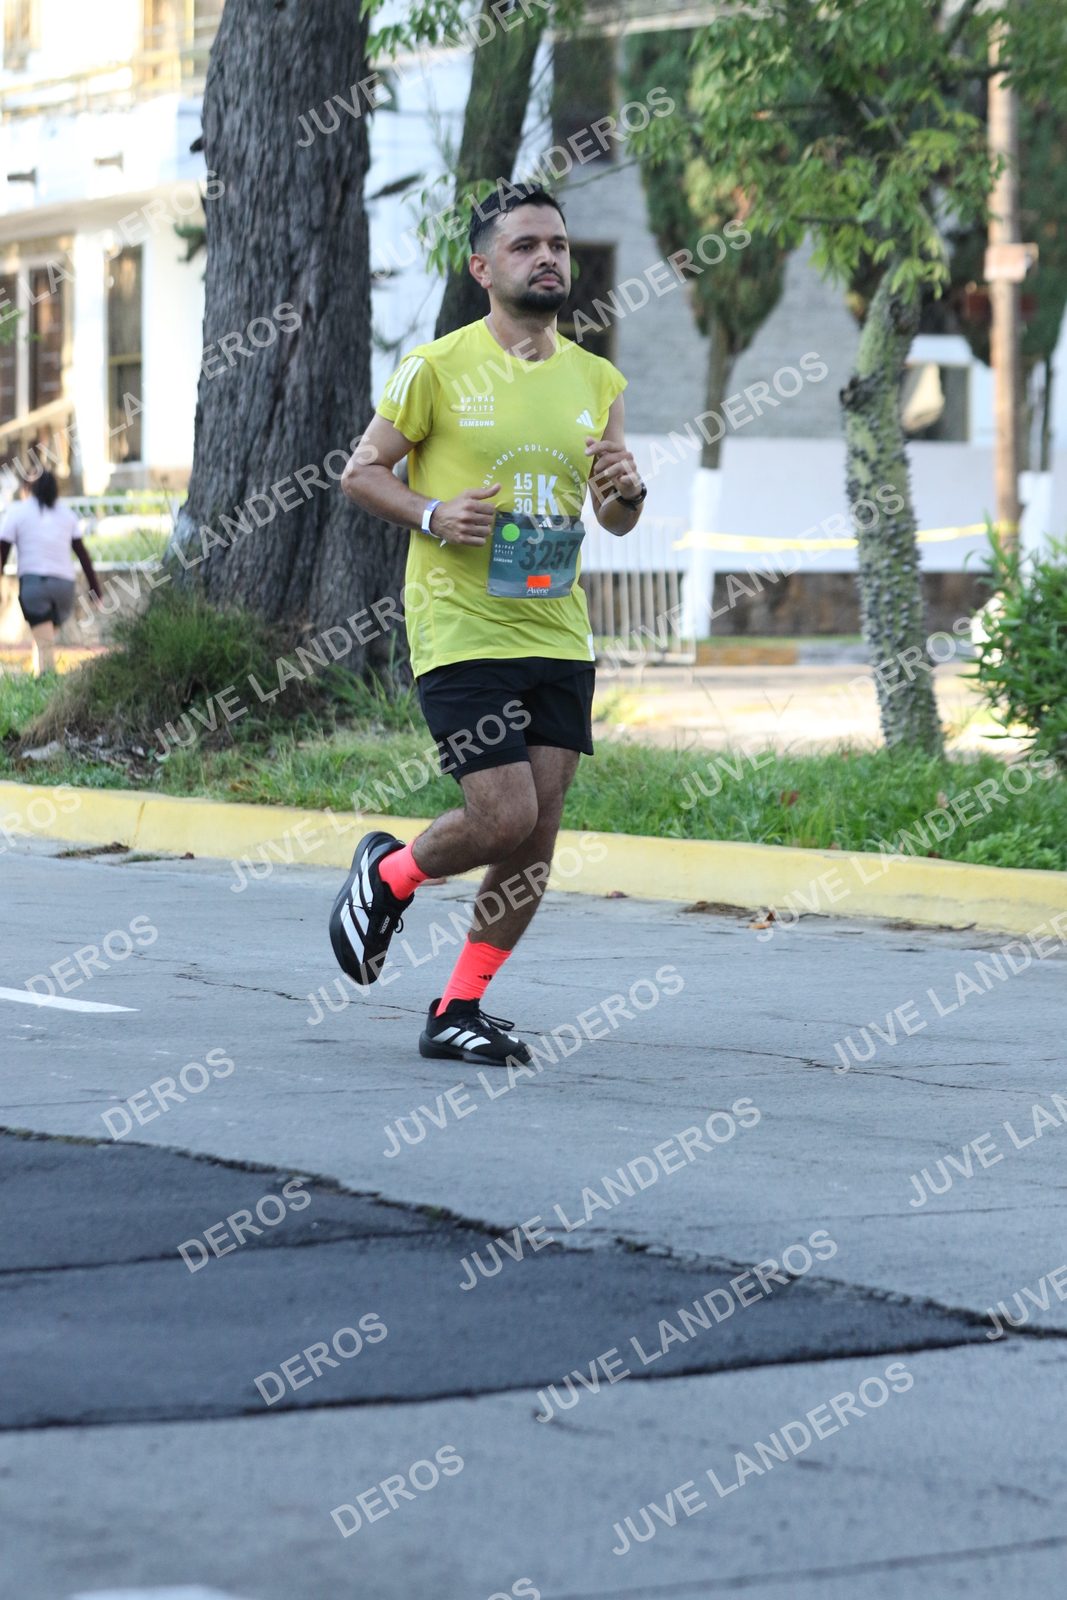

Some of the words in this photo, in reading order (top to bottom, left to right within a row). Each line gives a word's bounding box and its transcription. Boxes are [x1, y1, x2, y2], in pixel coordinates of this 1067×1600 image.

[496, 450, 515, 466] GDL
[524, 444, 542, 453] GDL
[552, 449, 569, 465] GDL
[513, 472, 533, 490] 15
[536, 473, 560, 516] K
[513, 497, 533, 515] 30
[519, 540, 579, 571] 3257
